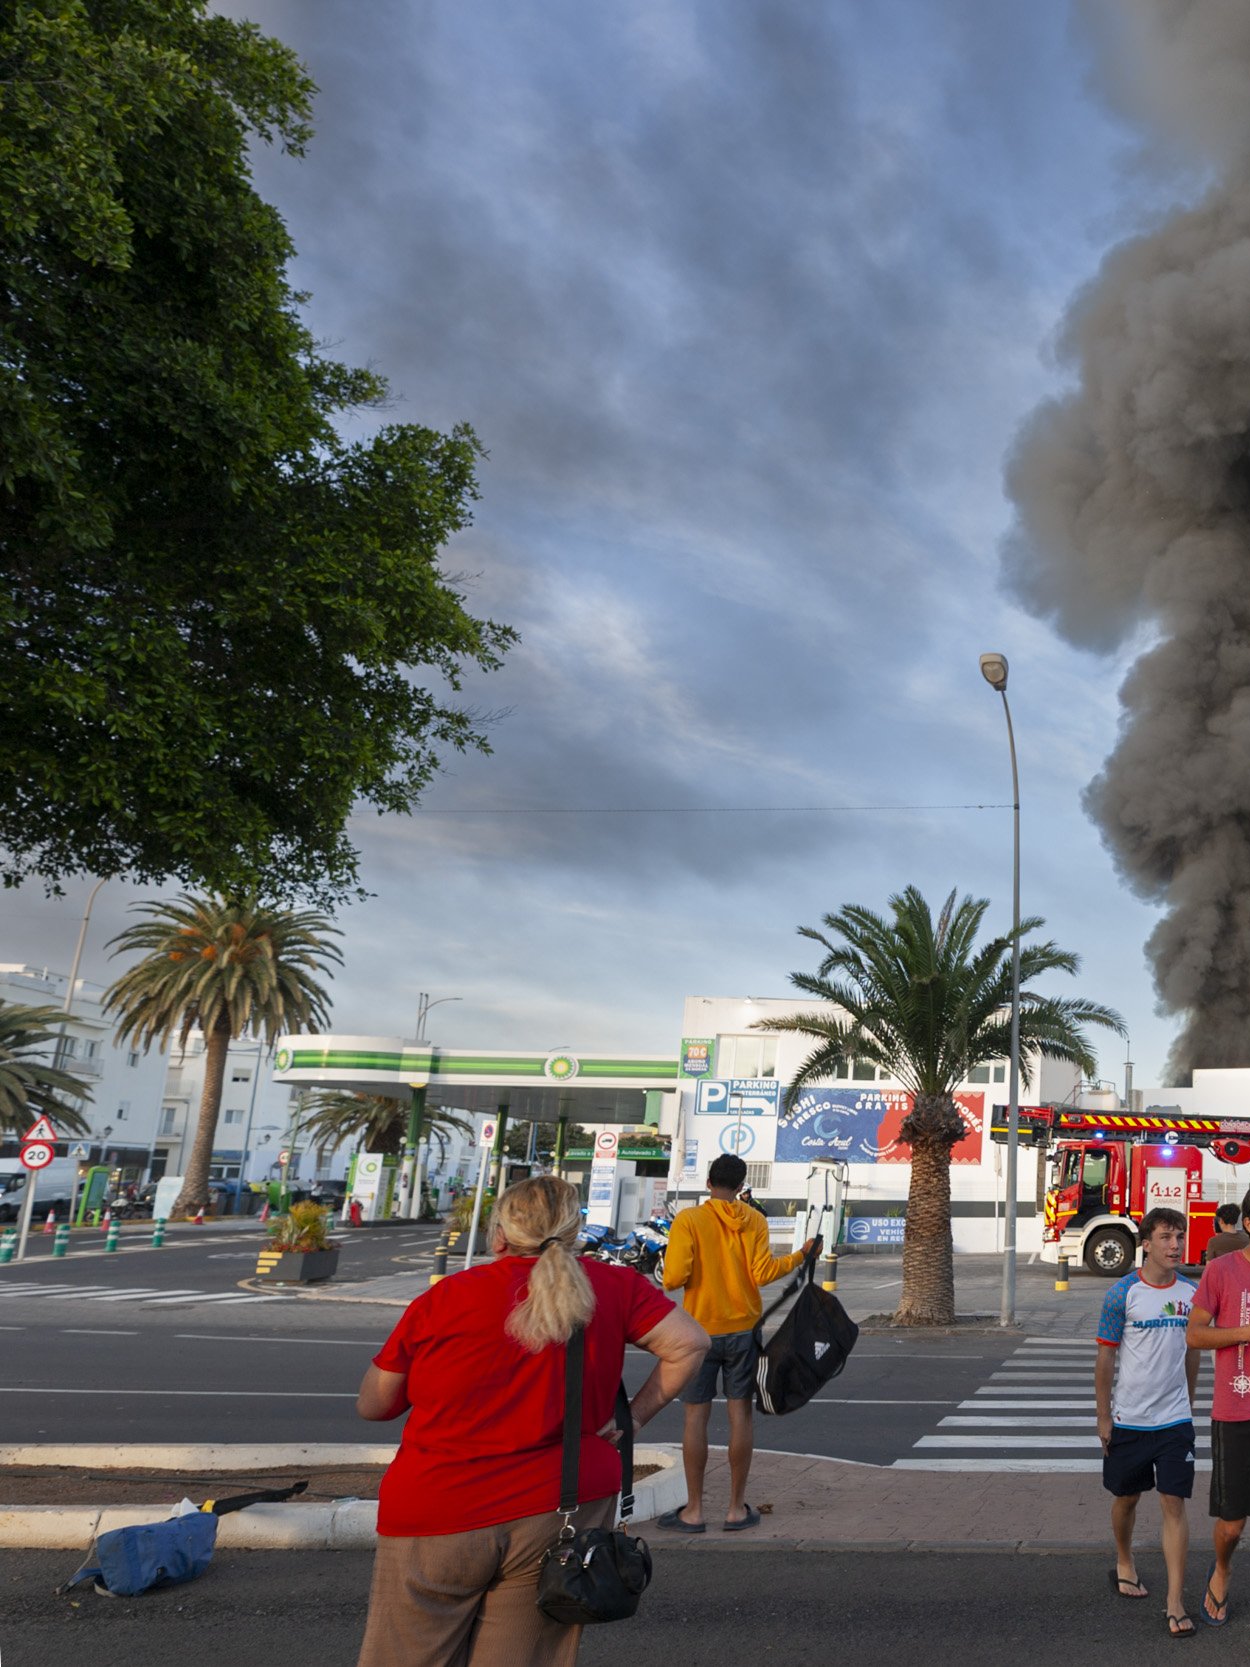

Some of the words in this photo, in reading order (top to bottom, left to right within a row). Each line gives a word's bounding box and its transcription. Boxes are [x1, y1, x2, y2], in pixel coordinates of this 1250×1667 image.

[733, 1080, 777, 1089] PARKING
[700, 1082, 727, 1112] P
[860, 1093, 907, 1102] PARKING
[855, 1102, 909, 1111] GRATIS
[792, 1101, 831, 1130] FRESCO
[801, 1136, 825, 1146] Costa
[828, 1136, 853, 1147] Azul
[27, 1151, 46, 1160] 20
[872, 1218, 889, 1227] USO
